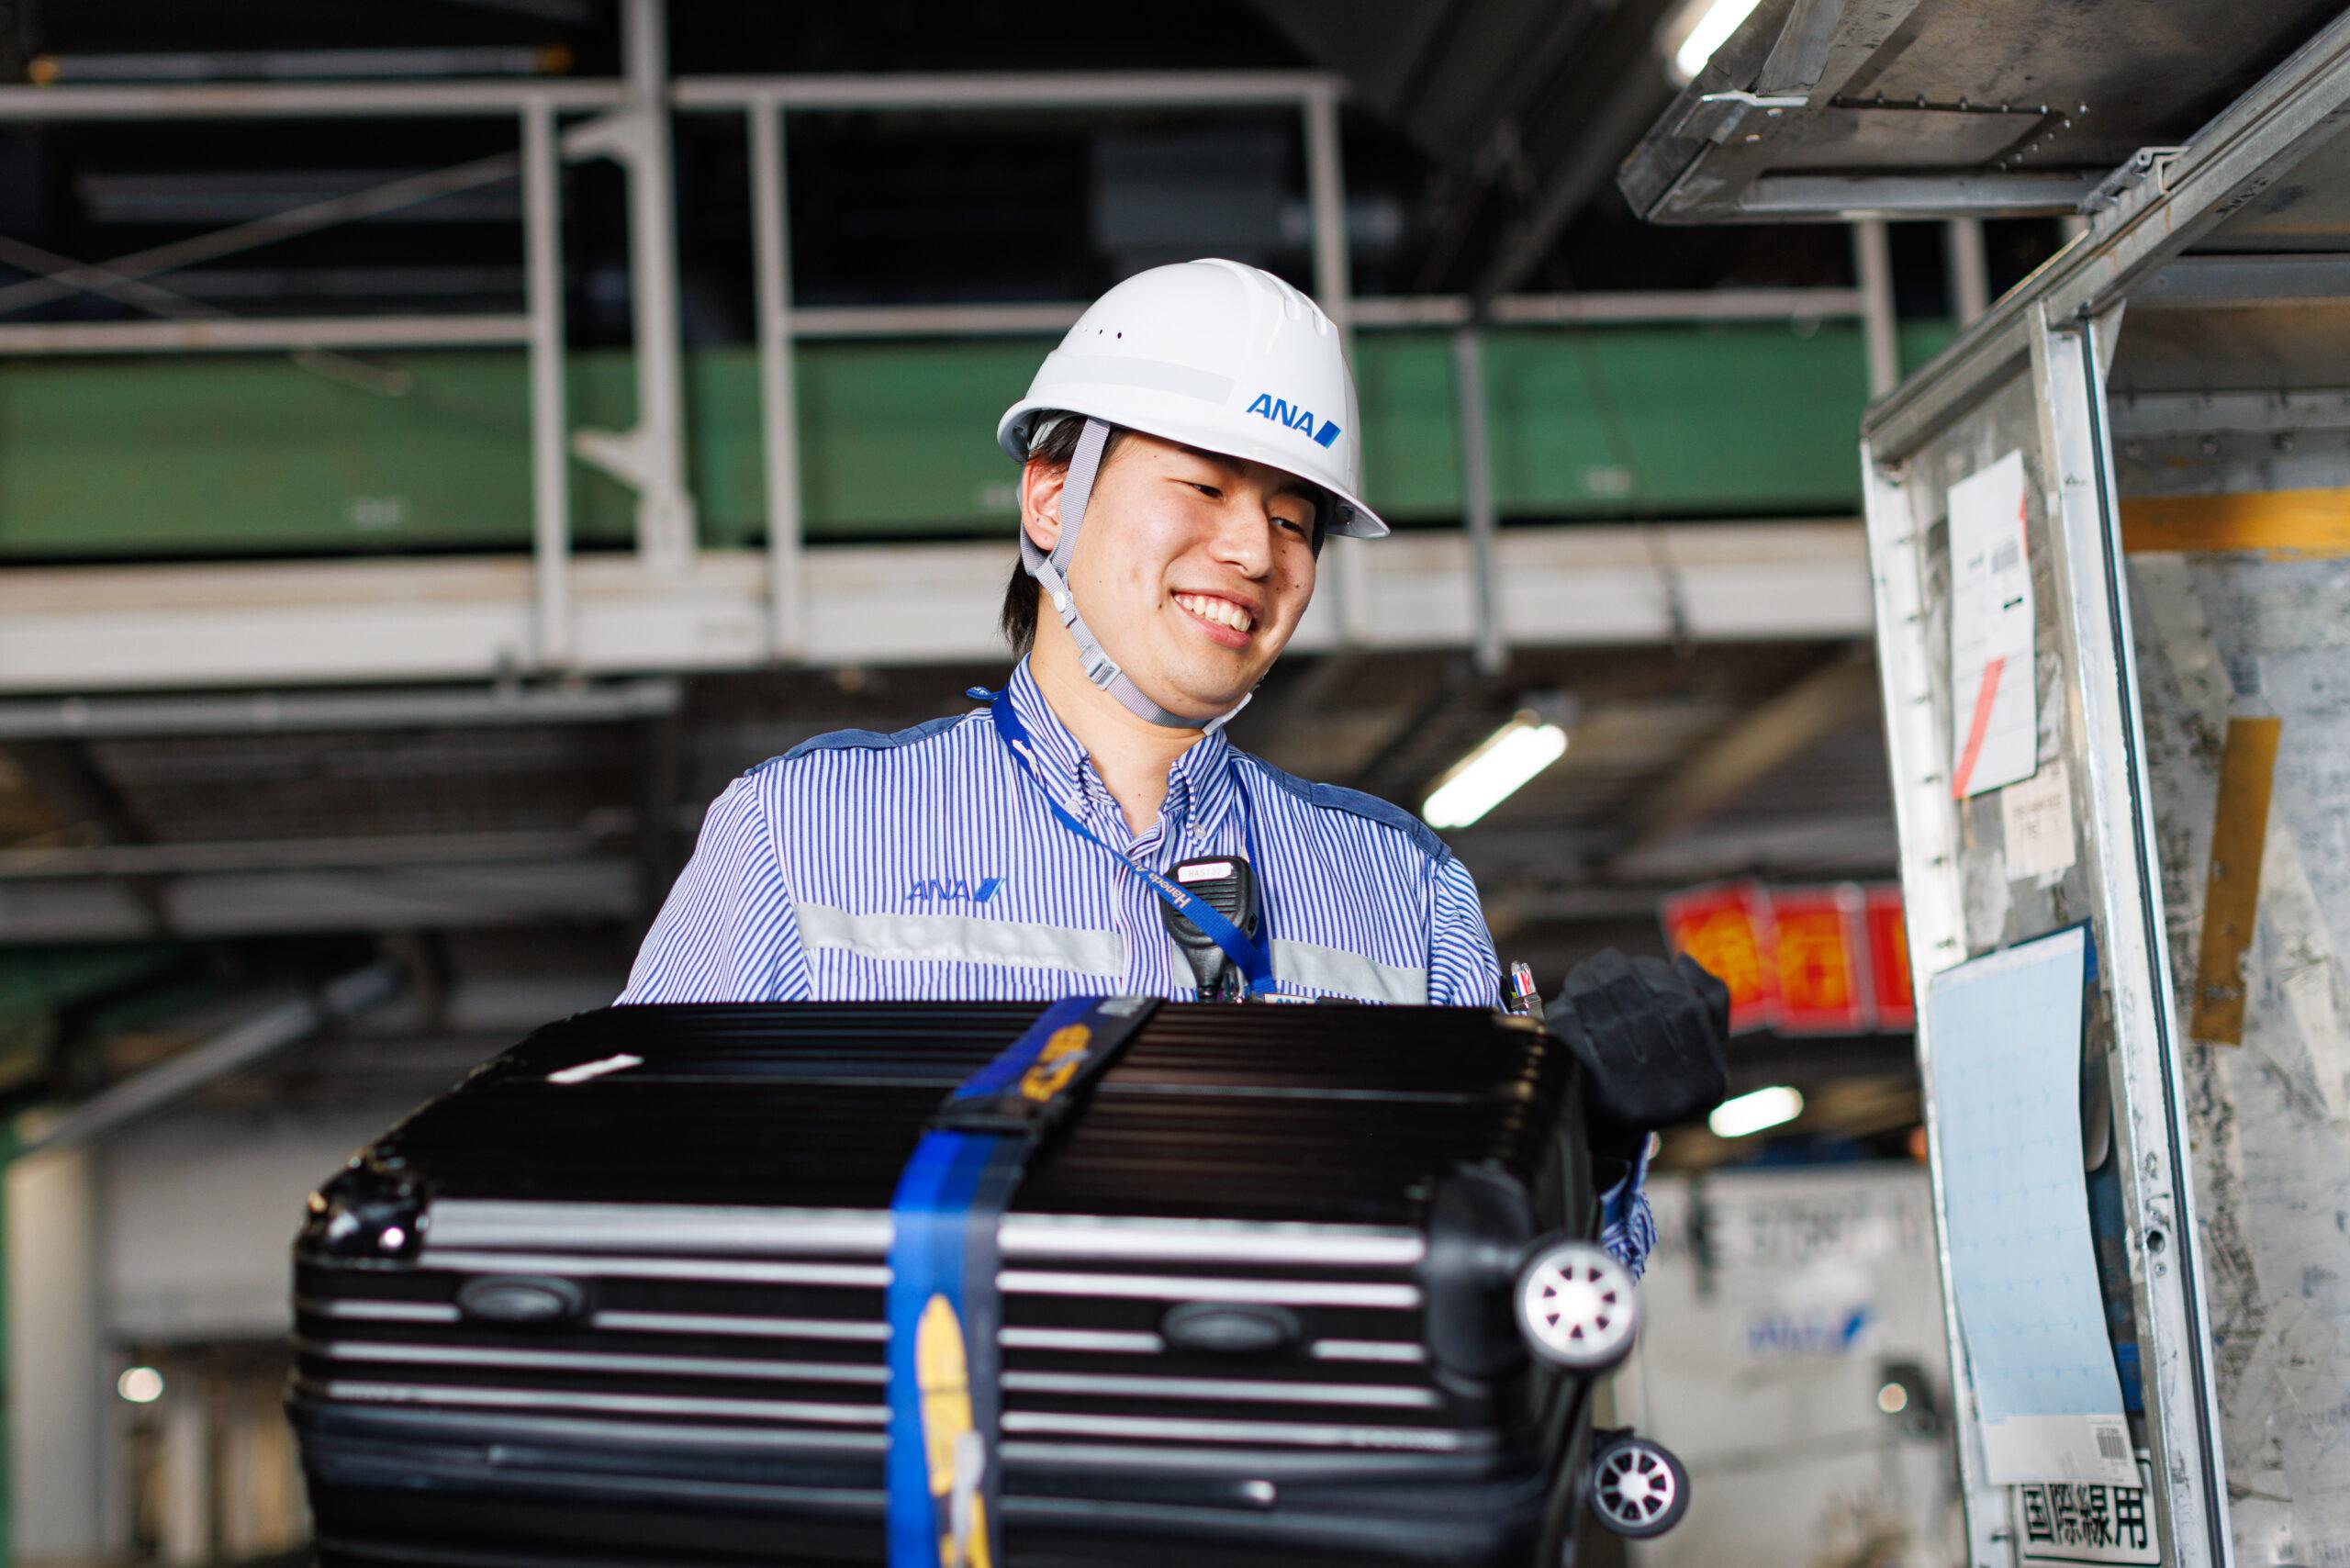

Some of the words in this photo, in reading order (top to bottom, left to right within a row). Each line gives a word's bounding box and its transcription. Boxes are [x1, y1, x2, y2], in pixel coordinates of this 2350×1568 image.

[1246, 393, 1314, 438] ANA
[906, 879, 971, 902] ANA
[1148, 872, 1192, 909] Haneda
[2021, 1484, 2147, 1549] 国際線用
